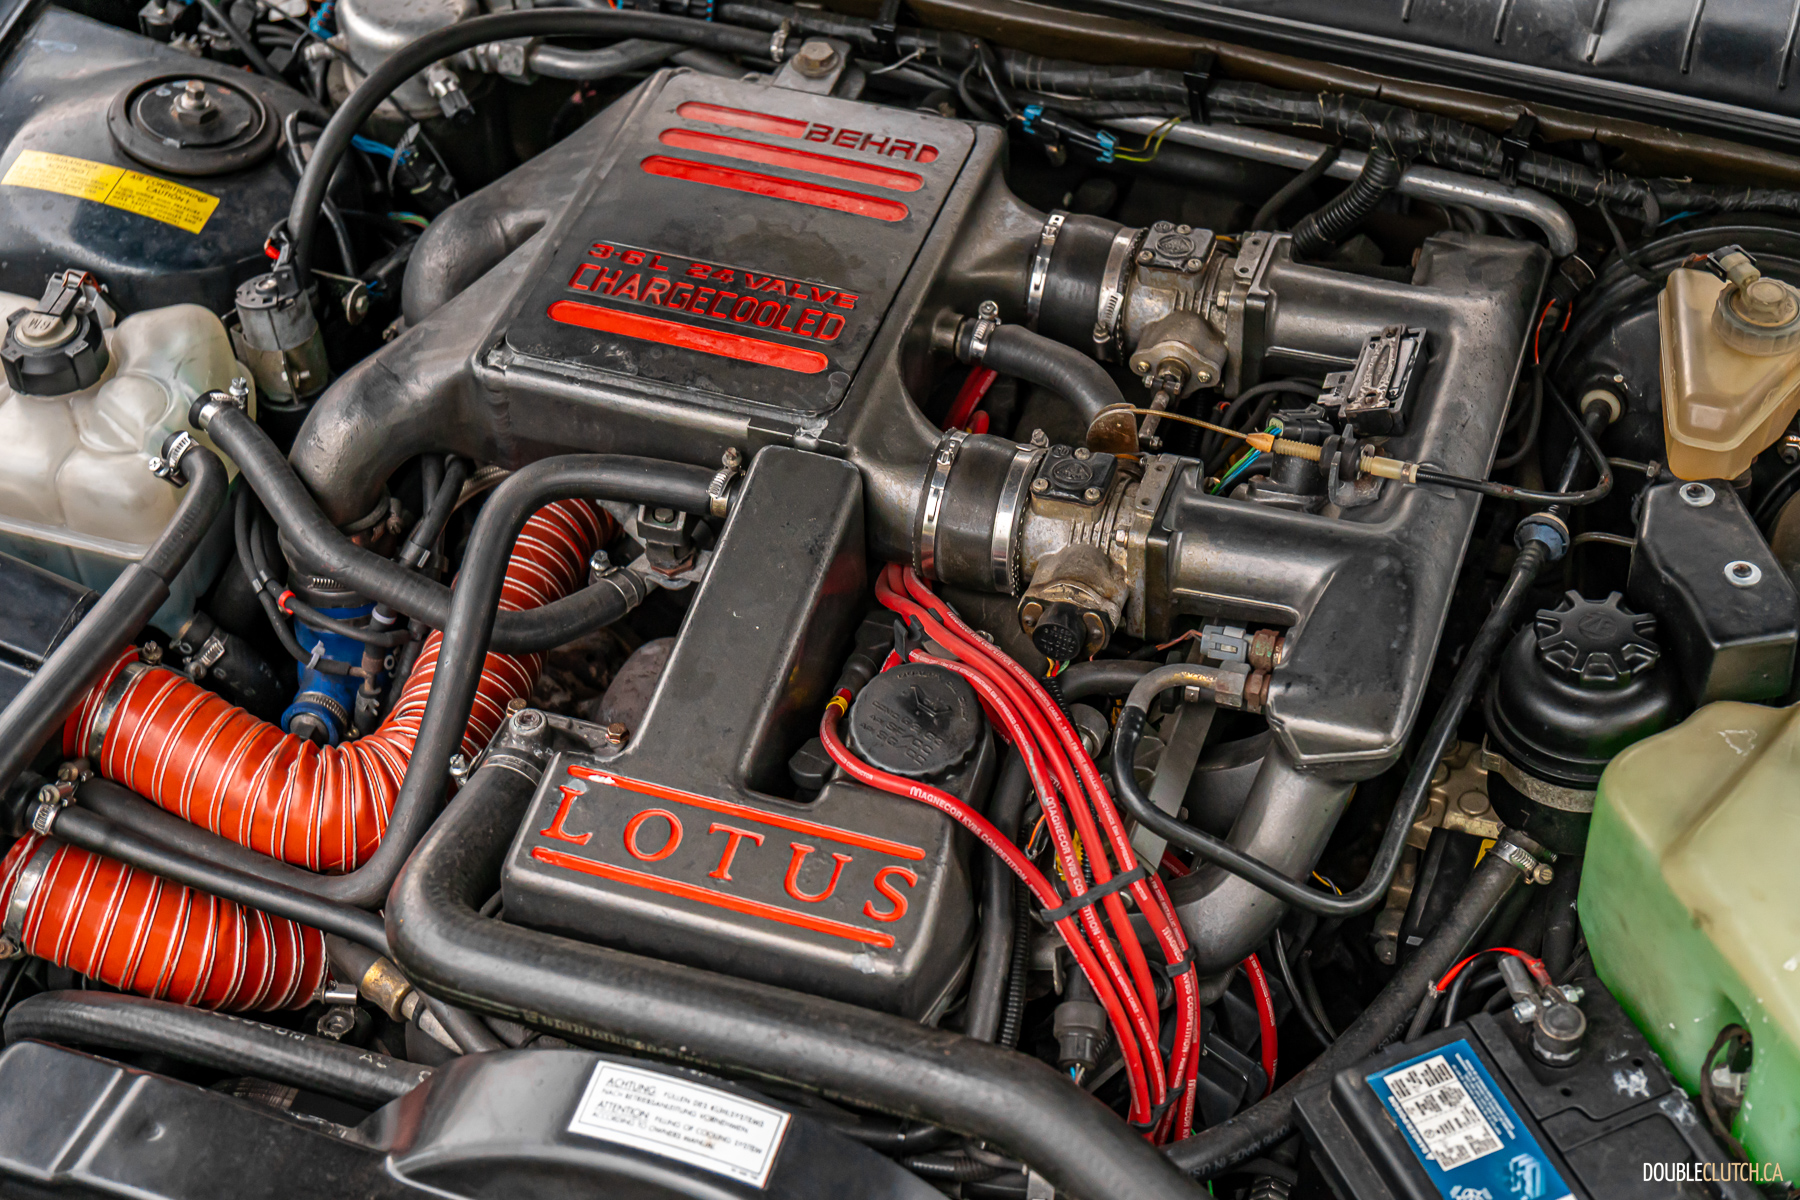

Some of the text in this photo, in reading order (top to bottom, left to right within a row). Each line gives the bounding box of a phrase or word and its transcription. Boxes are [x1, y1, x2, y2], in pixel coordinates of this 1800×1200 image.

[804, 122, 918, 160] BEHR
[144, 177, 208, 204] CONDITIONING
[146, 186, 185, 202] CAUTION
[568, 262, 846, 341] CHARGECOOLED
[686, 262, 735, 284] 24
[745, 273, 859, 310] VALVE
[844, 760, 873, 780] CONDUCTOR
[908, 785, 963, 819] MAGNECOR
[979, 831, 1028, 881] COMPETITION
[1044, 795, 1071, 854] MAGNECOR
[540, 785, 918, 922] LOTUS
[1181, 995, 1193, 1053] COMPETITION
[606, 1076, 658, 1096] ACHTUNG
[1183, 1078, 1196, 1127] MAGNECOR
[597, 1100, 650, 1120] ATTENTION
[696, 1126, 731, 1144] COOLING
